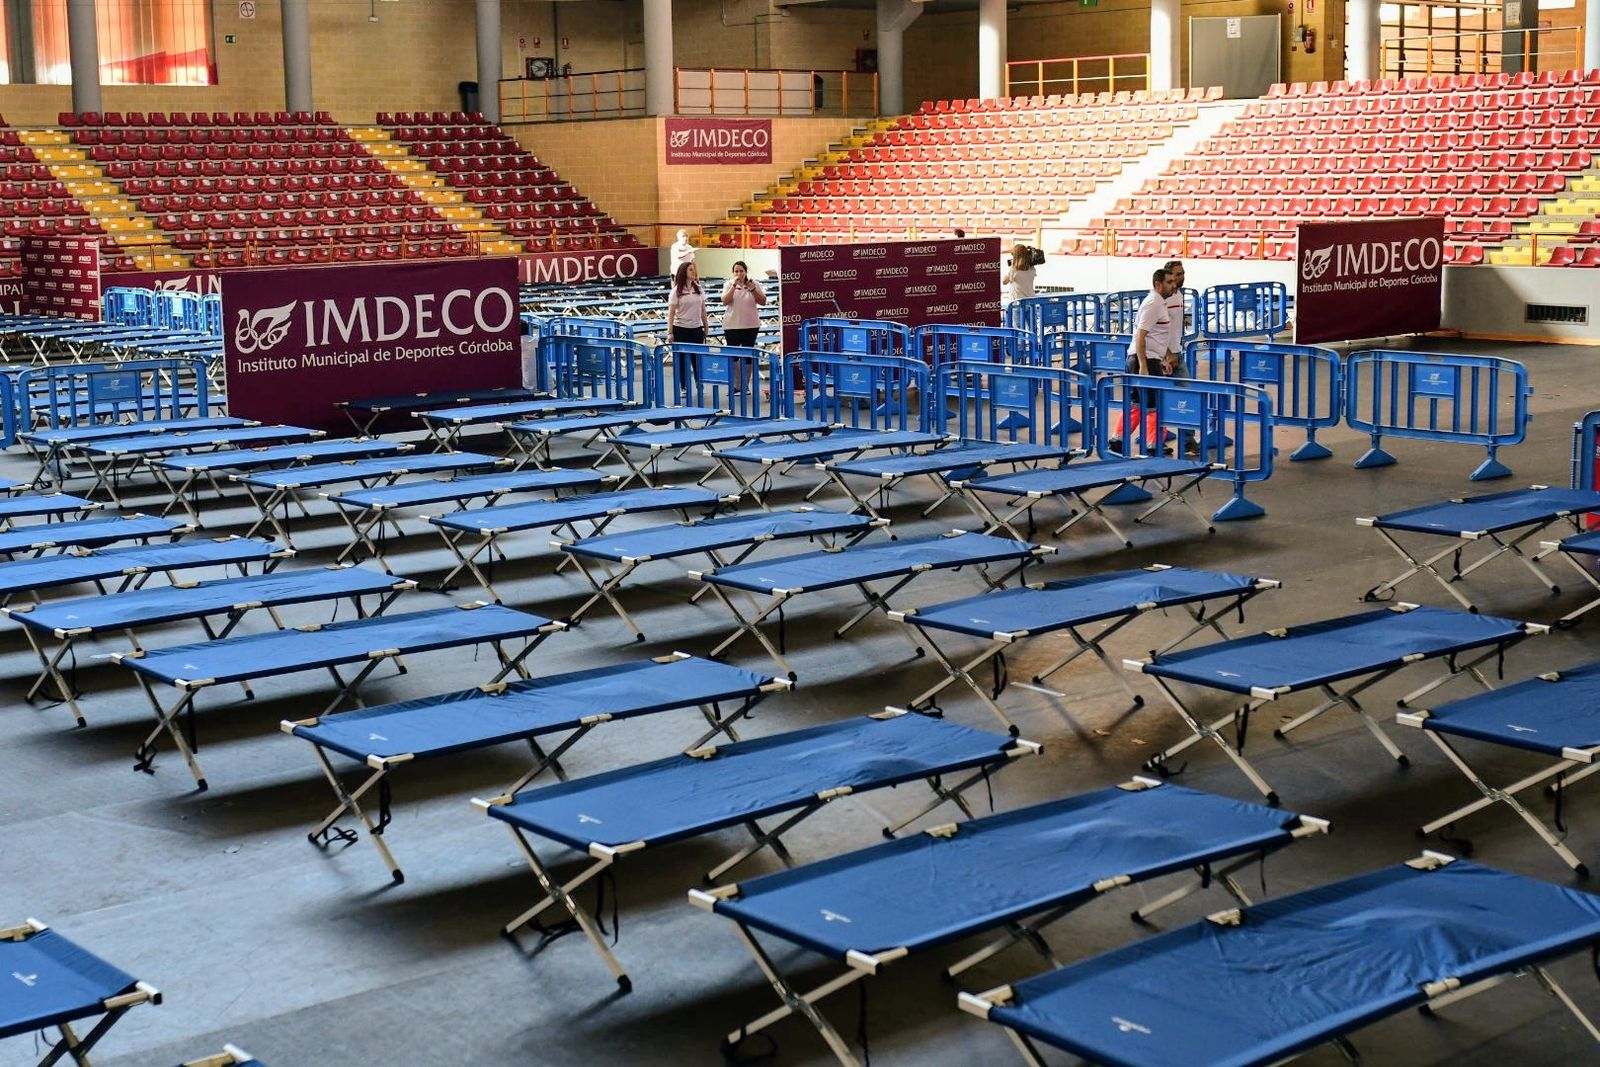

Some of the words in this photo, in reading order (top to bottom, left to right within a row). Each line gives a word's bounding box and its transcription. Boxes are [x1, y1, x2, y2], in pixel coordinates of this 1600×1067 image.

[693, 129, 768, 147] IMDECO
[807, 250, 834, 258] IMDECO
[1336, 237, 1440, 277] IMDECO
[525, 254, 638, 282] IMDECO
[808, 291, 835, 299] IMDECO
[1302, 283, 1332, 293] Instituto
[1334, 280, 1367, 291] Municipal
[1369, 279, 1378, 288] de
[1380, 276, 1409, 288] Deportes
[1411, 274, 1438, 284] Córdoba
[303, 287, 514, 348] IMDECO
[238, 357, 297, 373] Instituto
[301, 350, 369, 368] Municipal
[373, 348, 391, 362] de
[395, 344, 454, 360] Deportes
[459, 339, 513, 355] Córdoba
